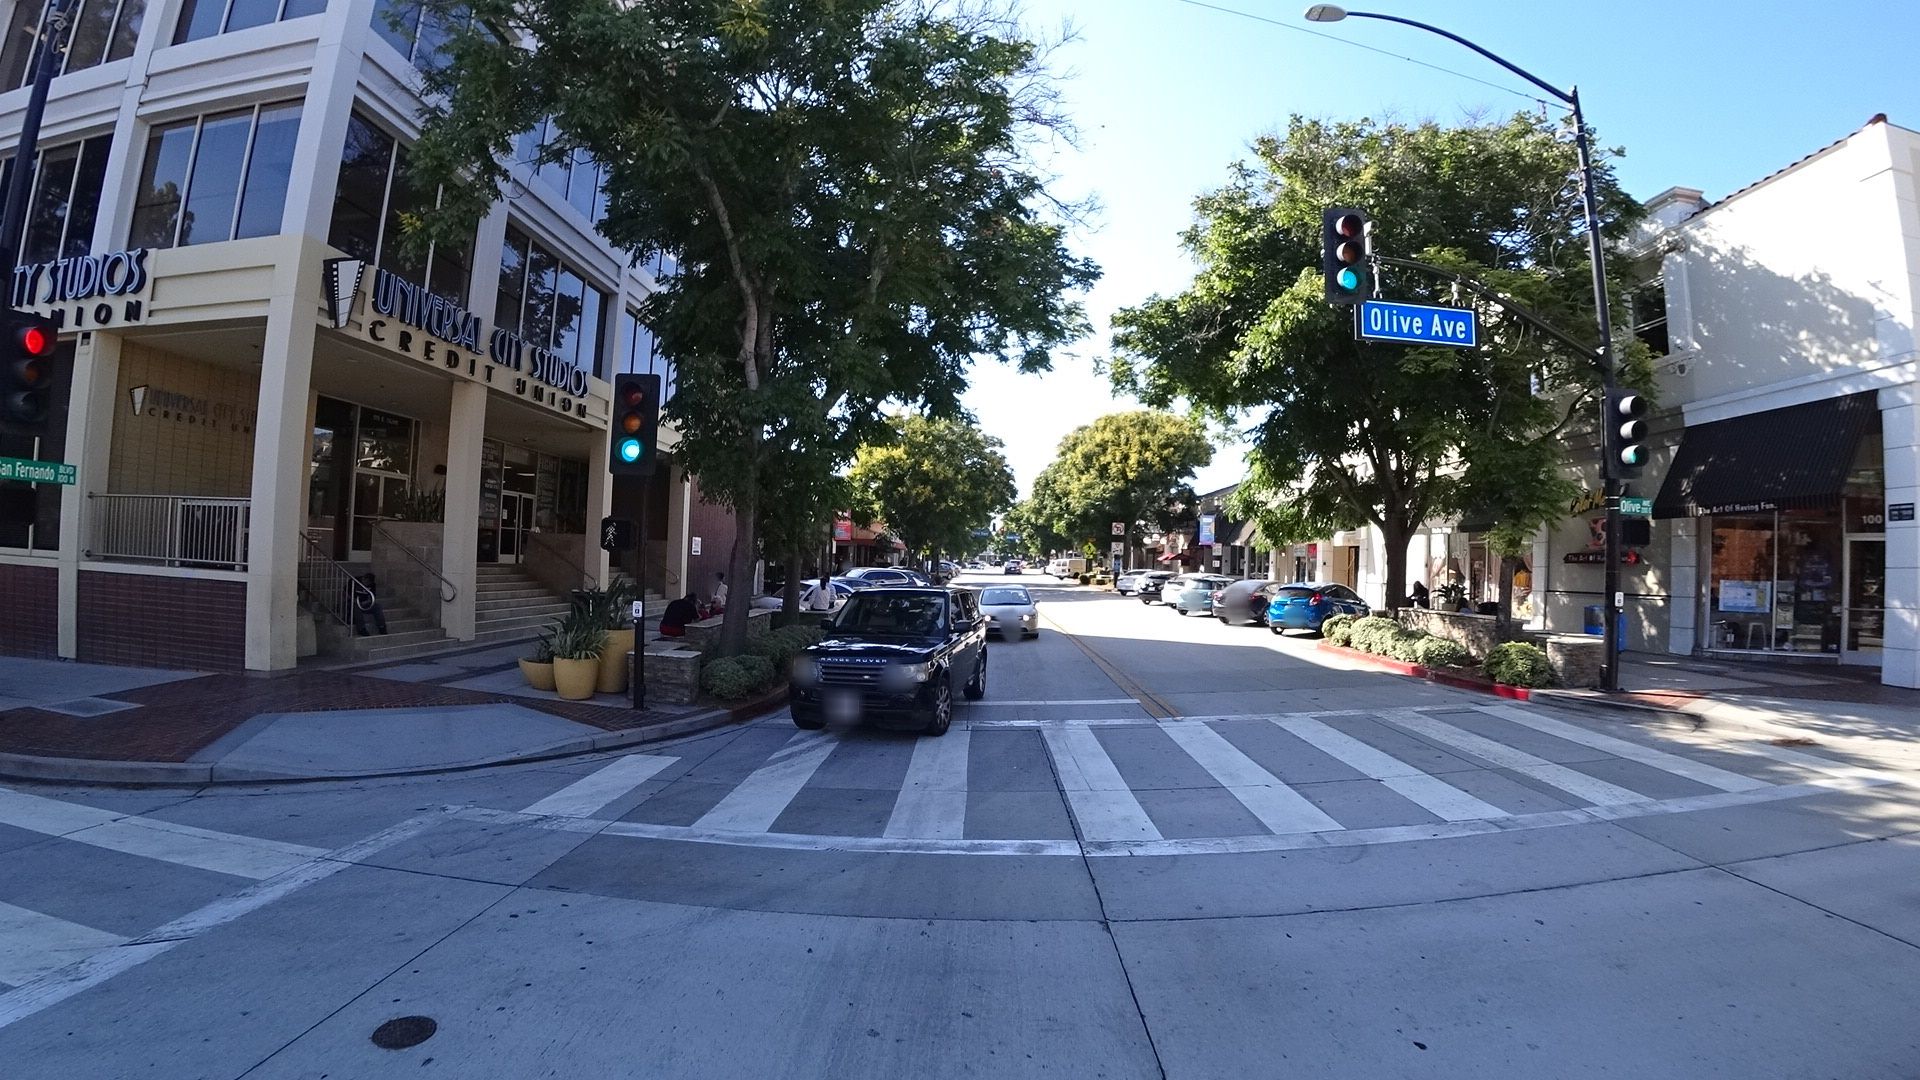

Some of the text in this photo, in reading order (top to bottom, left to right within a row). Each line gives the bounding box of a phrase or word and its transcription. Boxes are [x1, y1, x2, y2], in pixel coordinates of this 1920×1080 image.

[11, 248, 148, 307] TY STUDIOS
[50, 299, 142, 328] NION
[1370, 307, 1466, 339] Olive Ave
[372, 269, 589, 399] UNIVERSAL CITY STUDIOS
[369, 320, 586, 418] CREDIT UNION
[148, 407, 217, 428] CREDIT
[15, 462, 55, 480] Fernando
[59, 465, 74, 474] BLVD
[1620, 500, 1641, 513] Olive
[1698, 506, 1711, 516] The
[1712, 505, 1724, 513] Art
[1725, 504, 1734, 512] Of
[1862, 514, 1883, 524] 100
